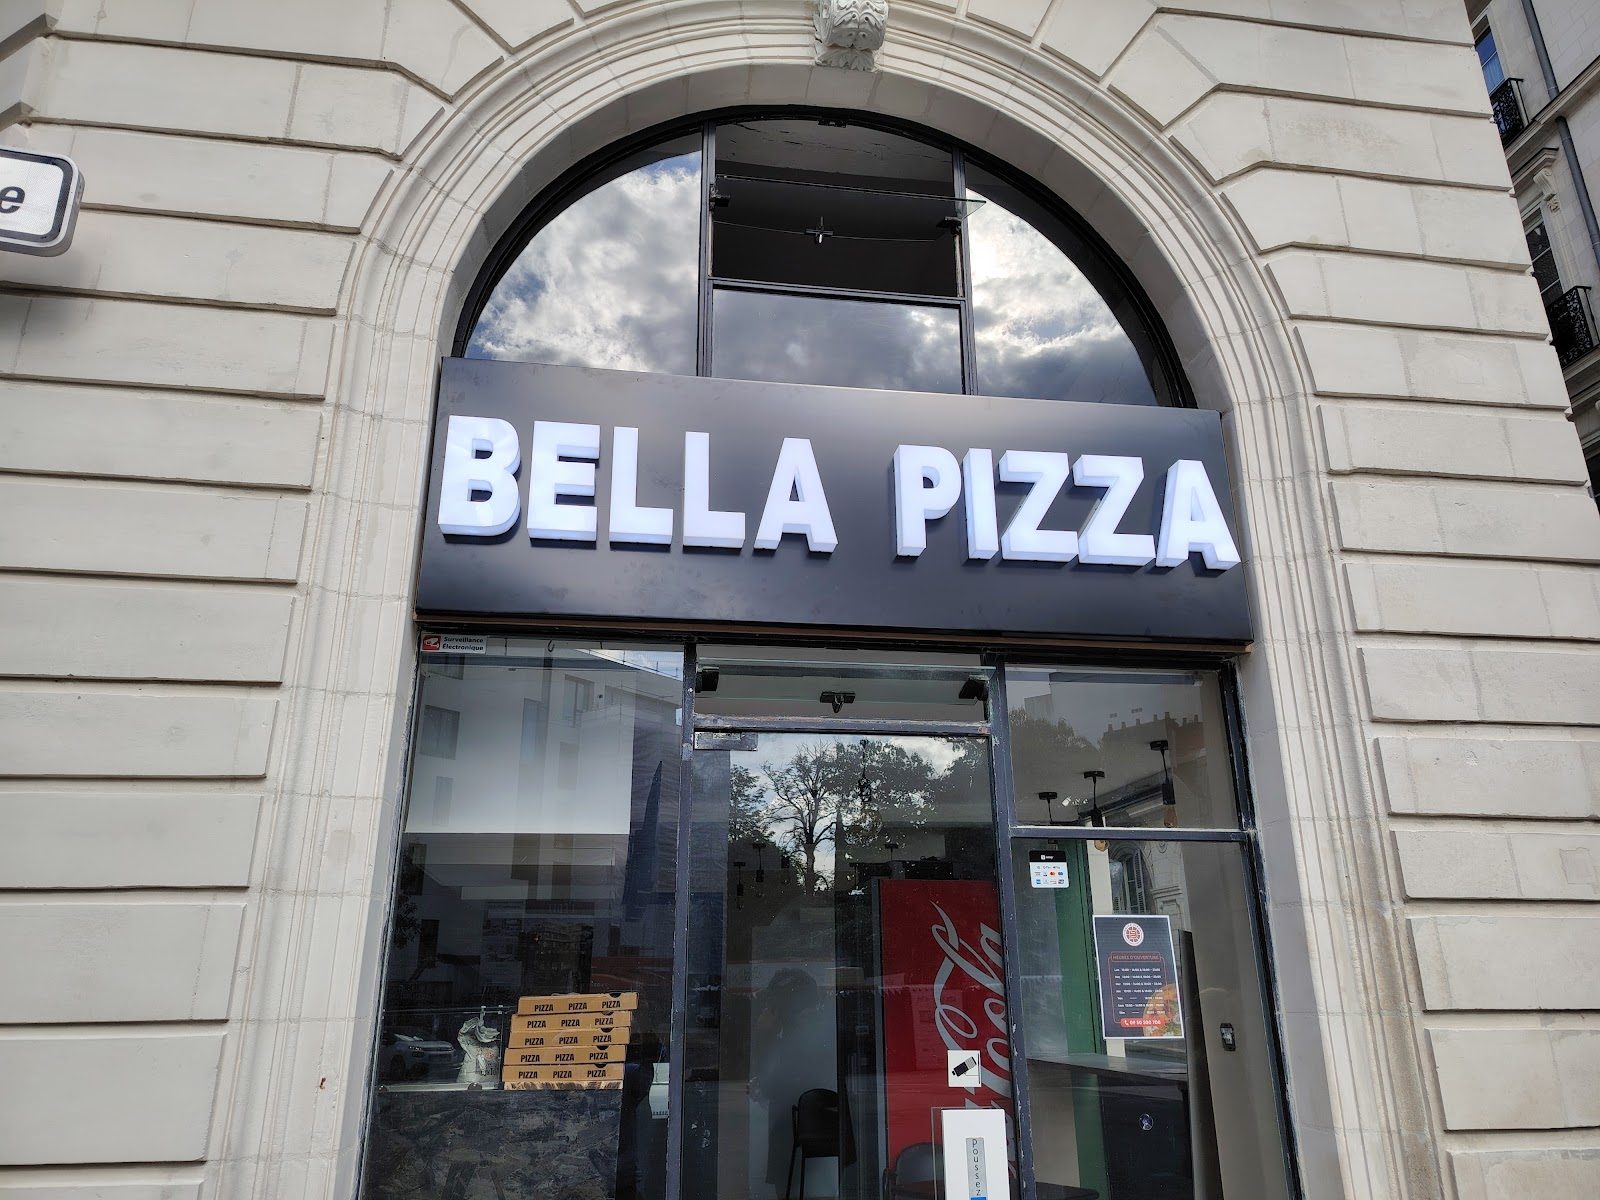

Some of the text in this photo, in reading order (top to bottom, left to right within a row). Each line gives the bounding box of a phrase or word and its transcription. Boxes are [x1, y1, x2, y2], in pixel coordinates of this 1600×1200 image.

[438, 415, 1241, 570] BELLA PIZZA
[534, 1000, 621, 1012] PIZZA PIZZA PIZZA
[527, 1017, 614, 1029] PIZZA PIZZA PIZZA
[524, 1034, 612, 1046] PIZZA PIZZA PIZZA
[520, 1052, 609, 1063] PIZZA PIZZA PIZZA
[518, 1069, 607, 1079] PIZZA PIZZA PIZZA
